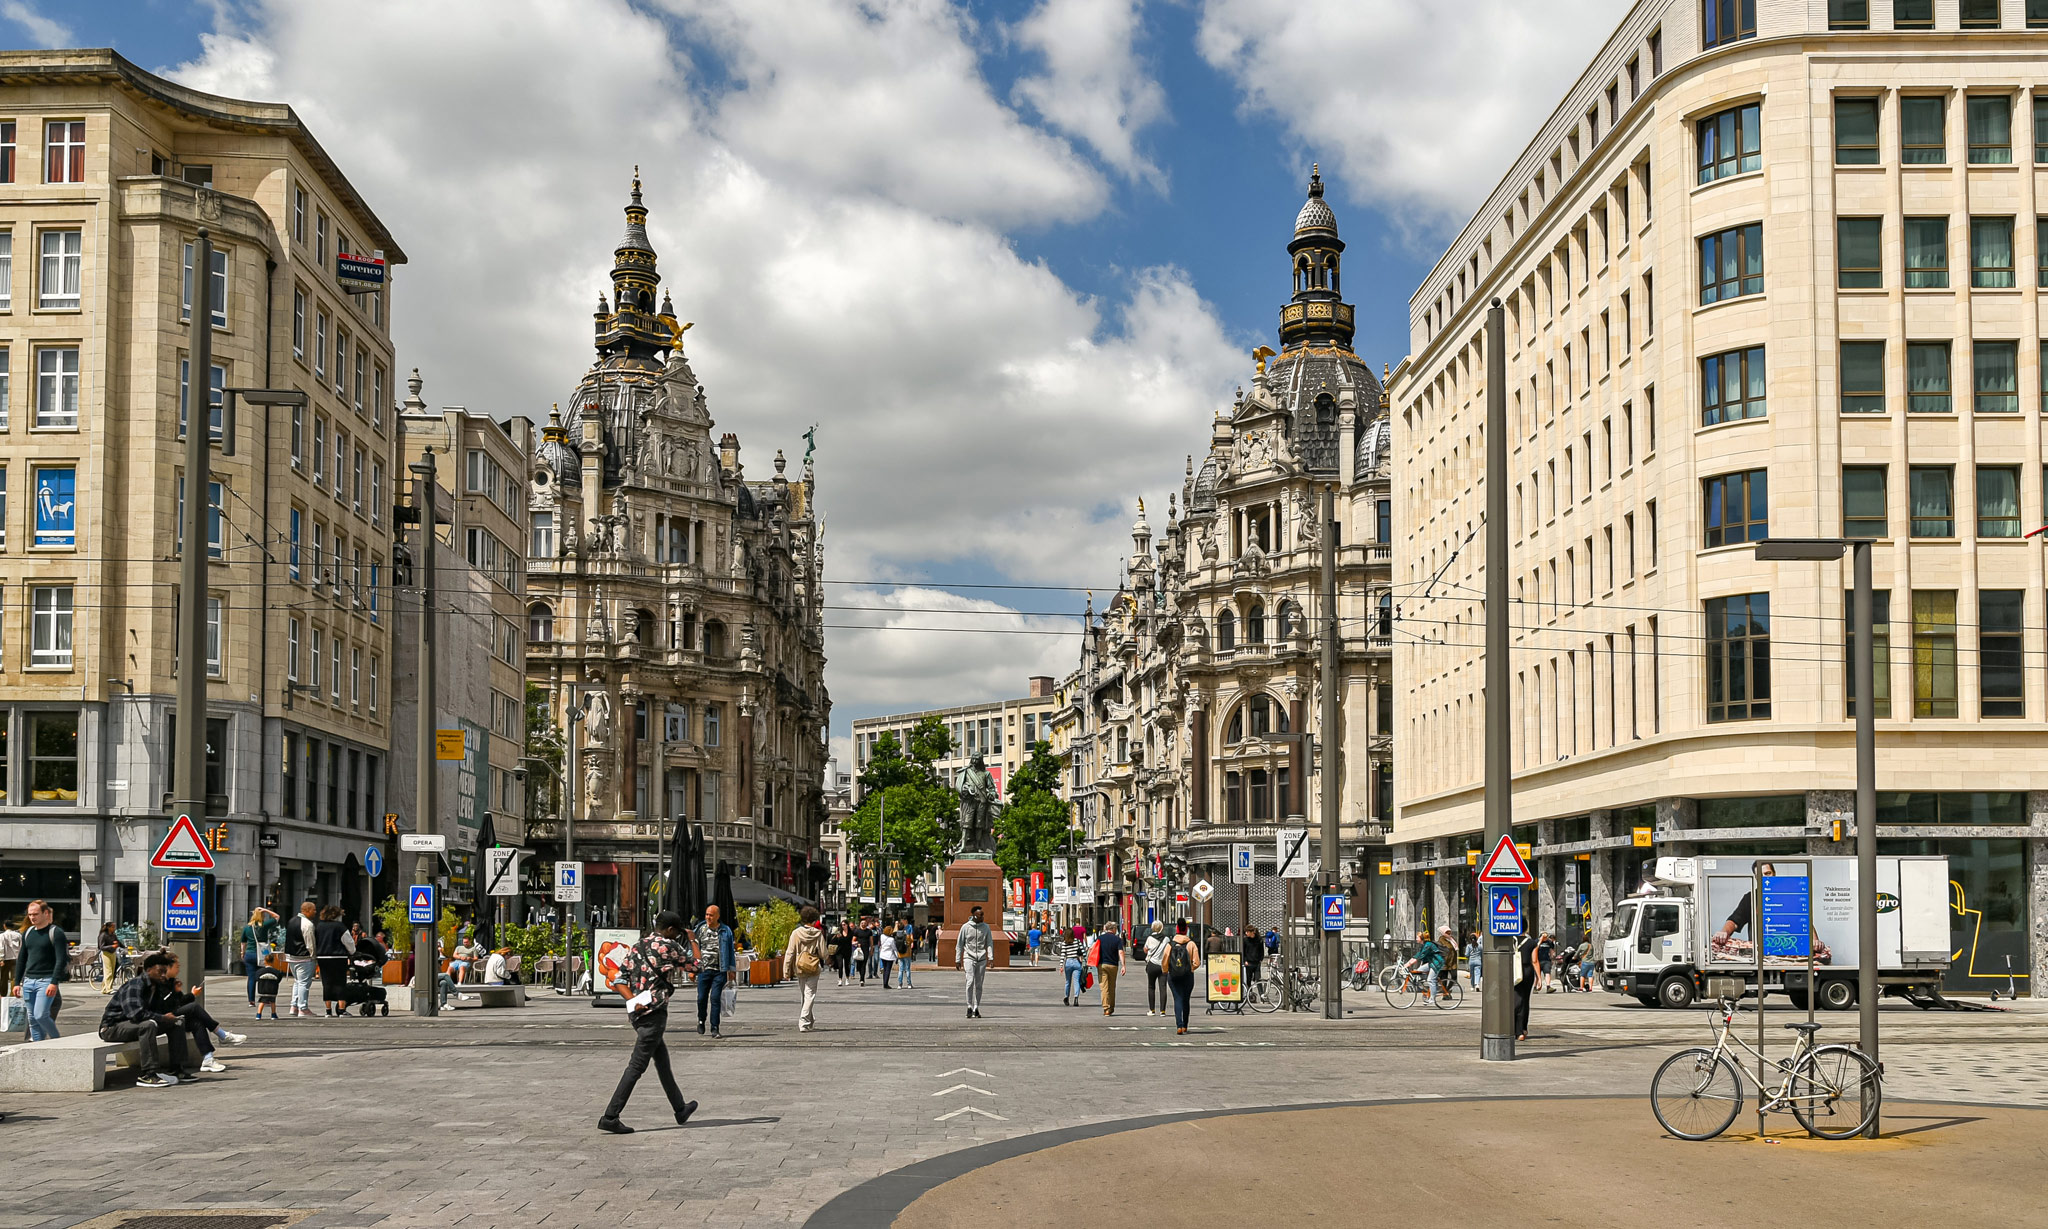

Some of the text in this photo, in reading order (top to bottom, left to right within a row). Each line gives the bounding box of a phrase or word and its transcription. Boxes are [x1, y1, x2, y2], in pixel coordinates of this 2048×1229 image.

[340, 263, 382, 276] sorenco
[412, 912, 430, 920] TRAM
[169, 916, 196, 927] TRAM
[1495, 921, 1518, 931] TRAM
